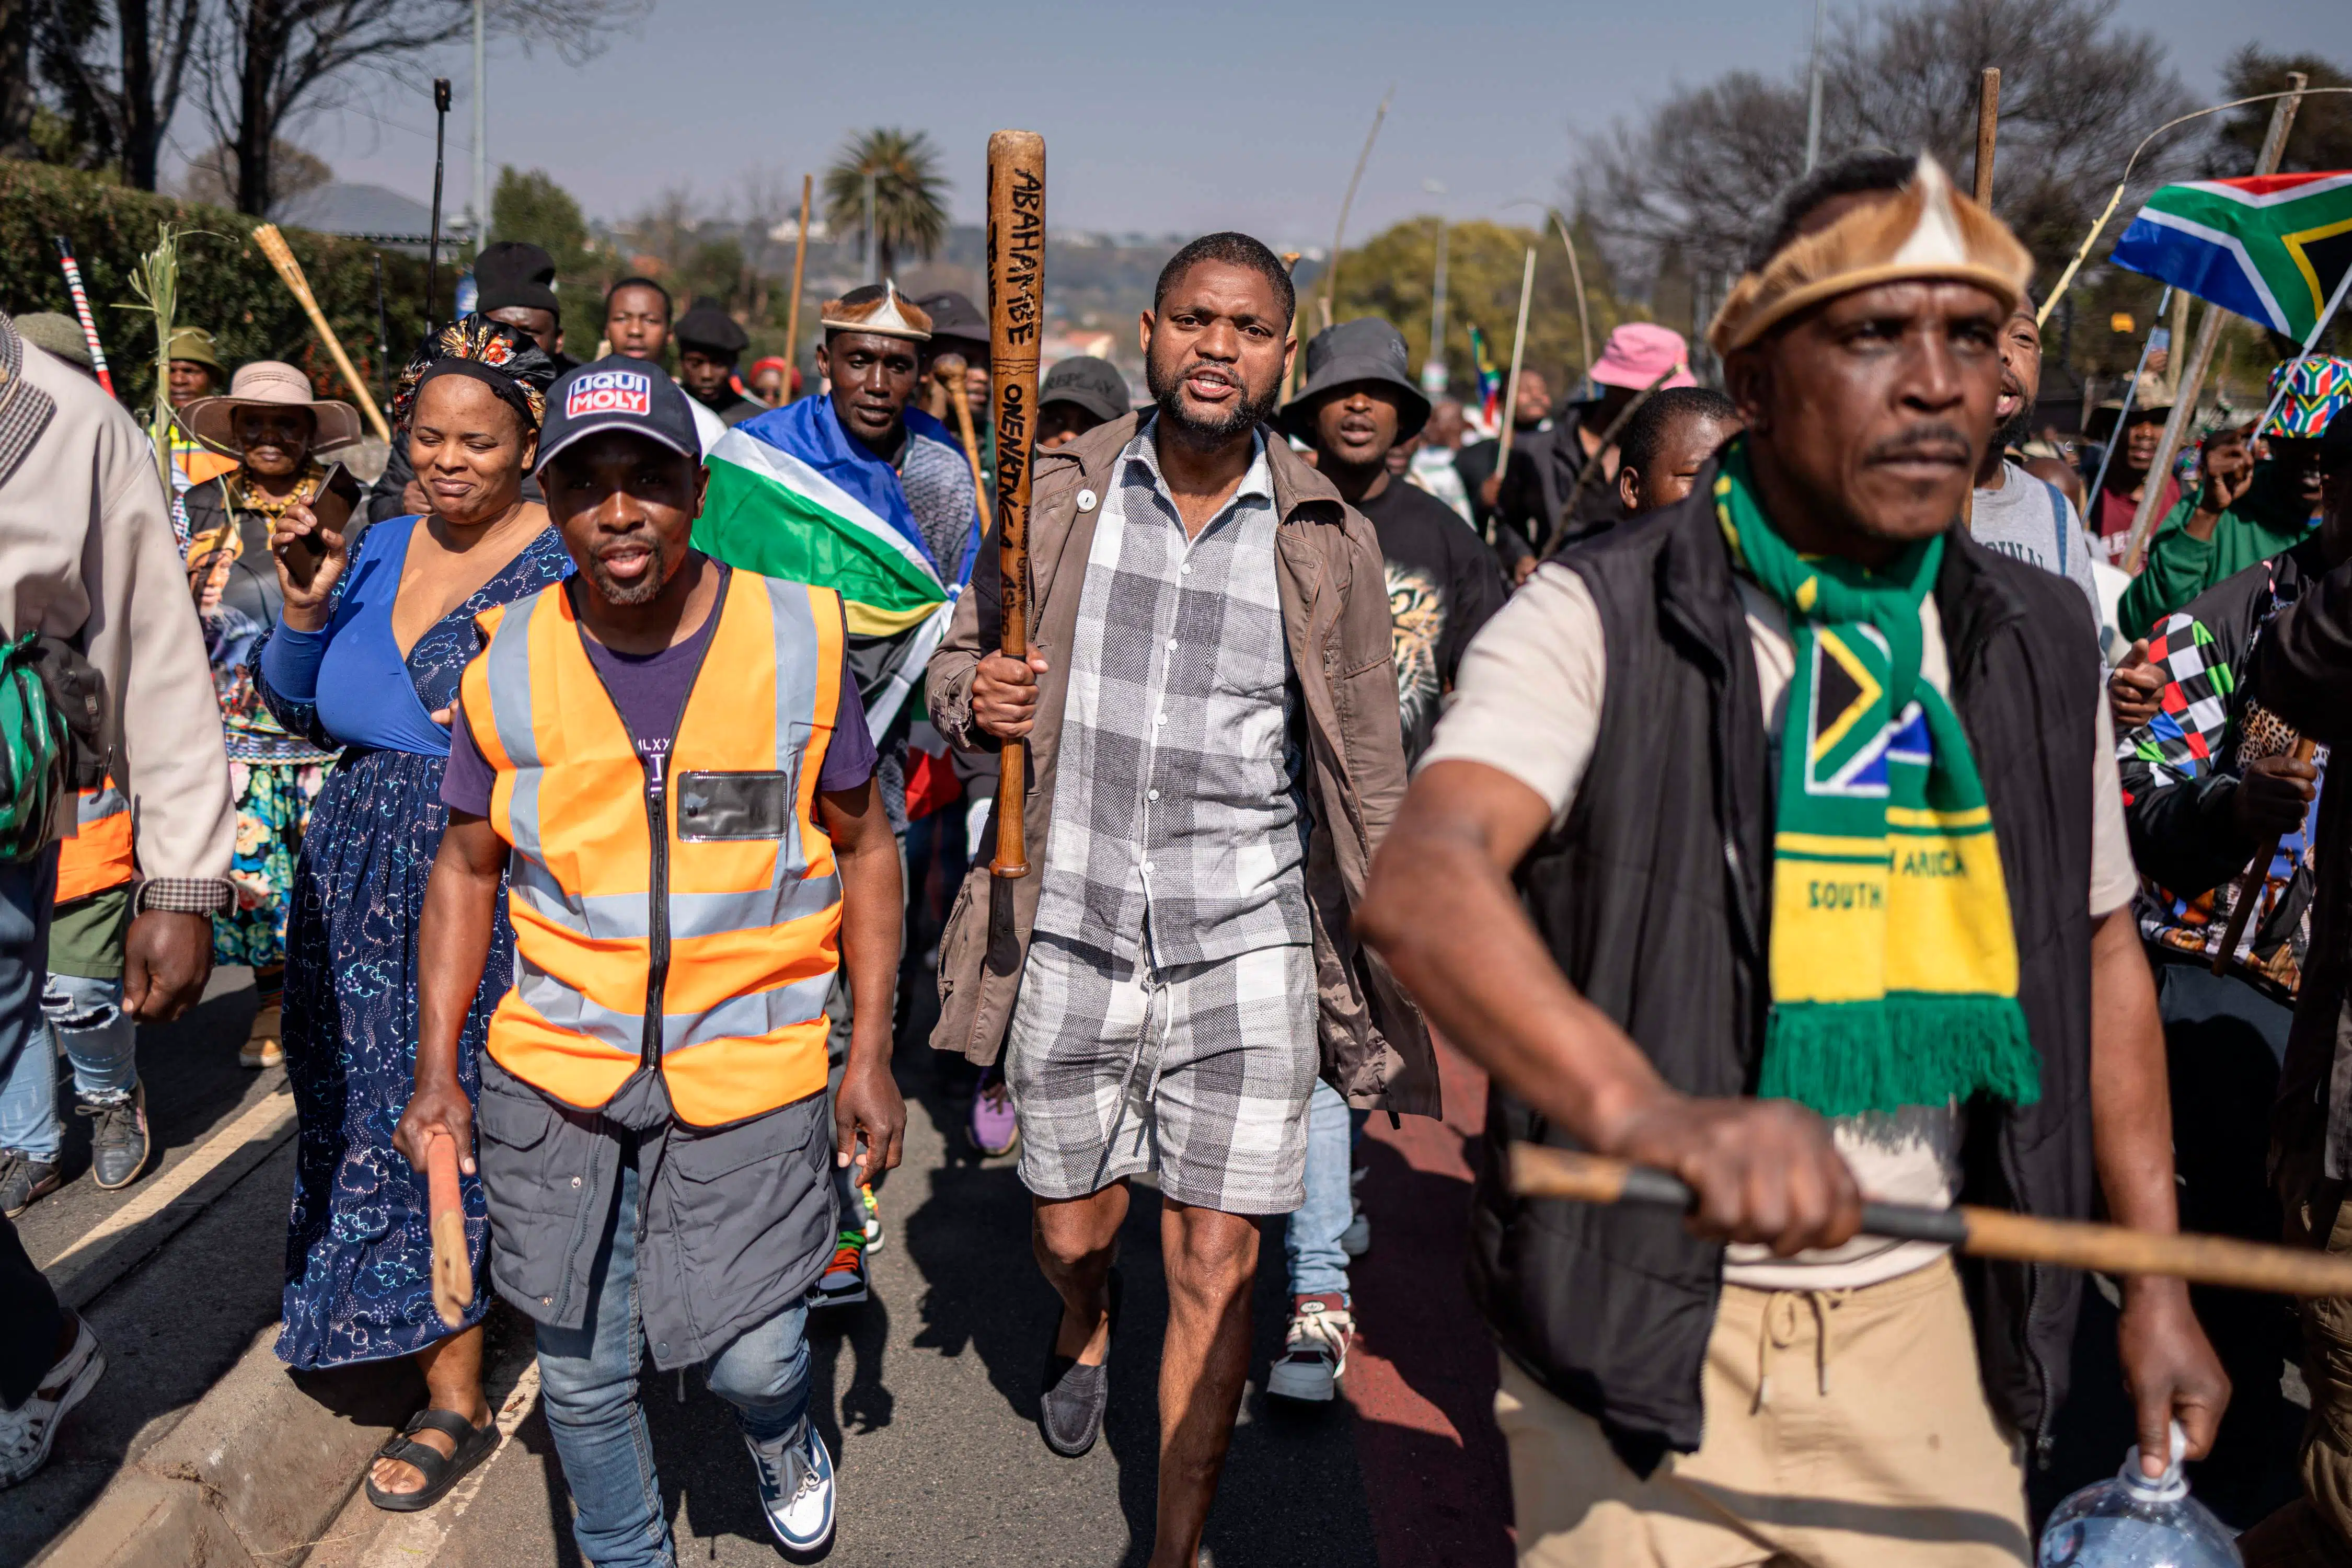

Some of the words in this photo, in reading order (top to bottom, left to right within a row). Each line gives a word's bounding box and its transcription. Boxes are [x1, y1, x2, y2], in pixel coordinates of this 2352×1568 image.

[1006, 168, 1042, 345] ABAHAMBE
[574, 374, 643, 396] LIQUI
[572, 390, 644, 413] MOLY
[1808, 880, 1882, 909] SOUTH
